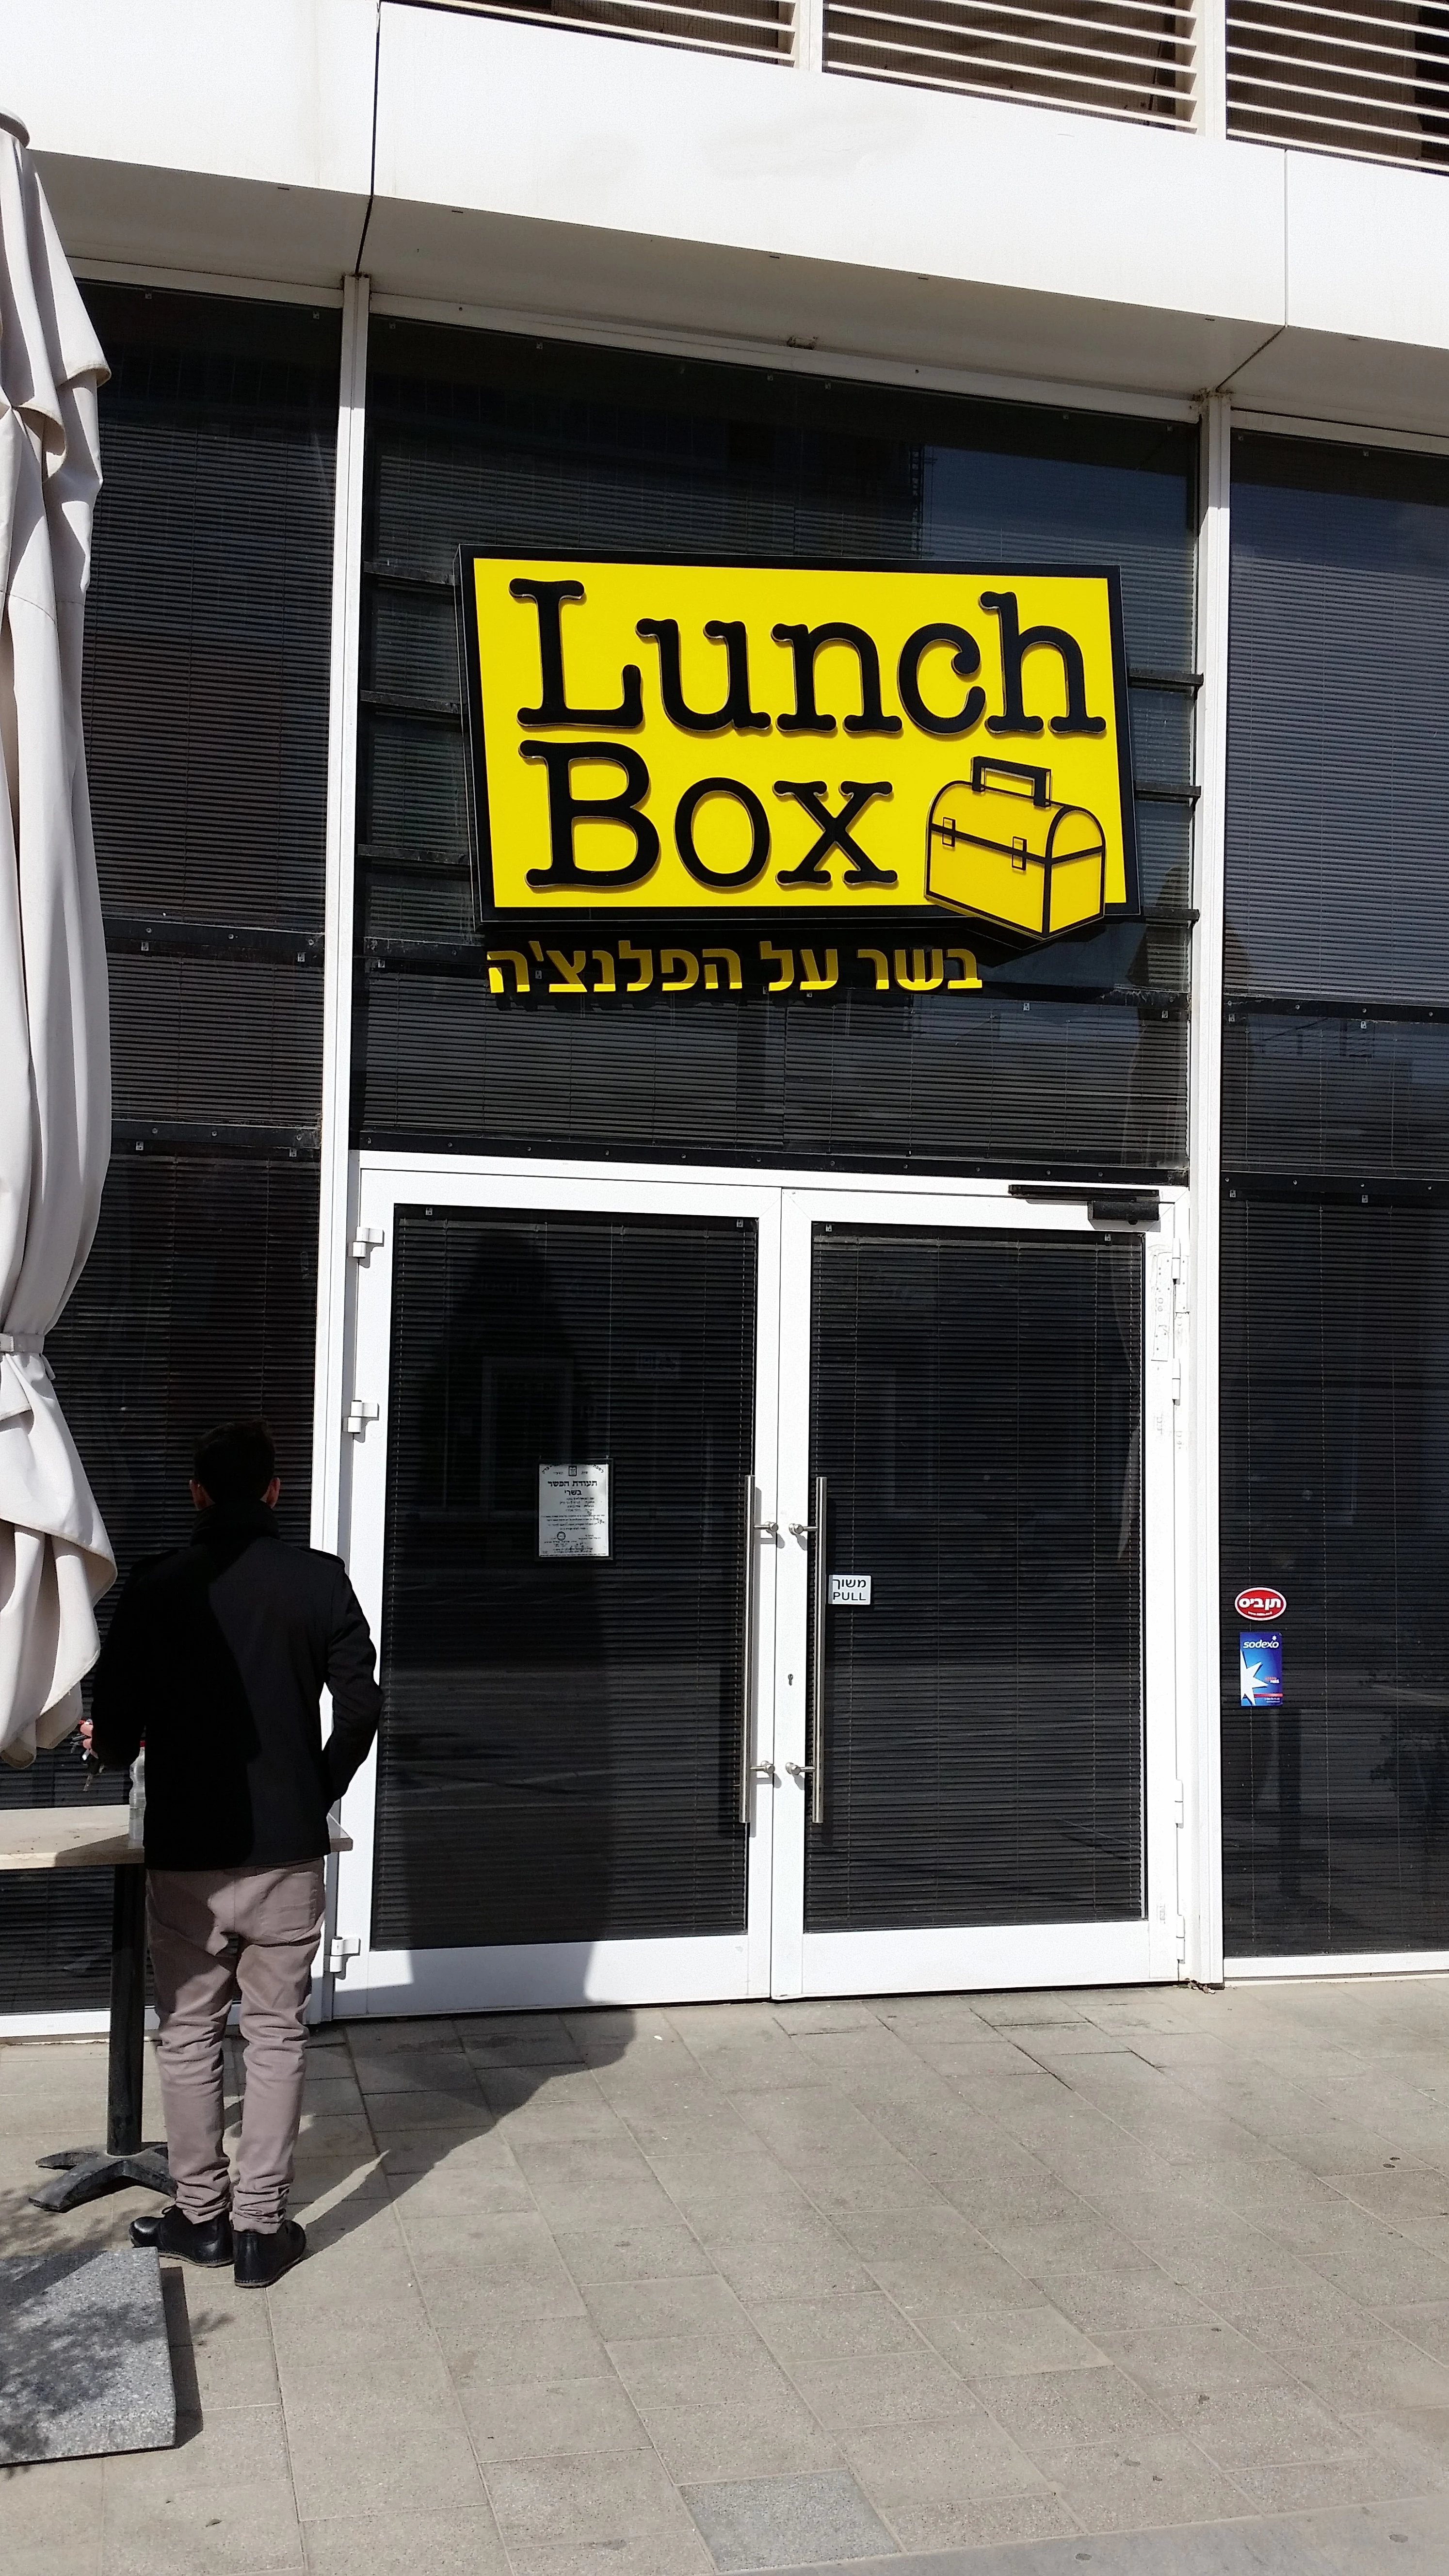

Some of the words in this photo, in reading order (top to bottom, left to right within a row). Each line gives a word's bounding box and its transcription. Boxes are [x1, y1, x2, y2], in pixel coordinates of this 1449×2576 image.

[509, 577, 1106, 735] Lunch
[518, 739, 899, 891] Box
[486, 940, 742, 993] הפלנצ'ה
[759, 940, 838, 992] על
[857, 948, 983, 991] בשר
[832, 1579, 867, 1590] משוך
[833, 1592, 867, 1601] PULL
[1239, 1598, 1264, 1608] ביס
[1264, 1598, 1281, 1611] תן
[1242, 1639, 1279, 1648] sodexo
